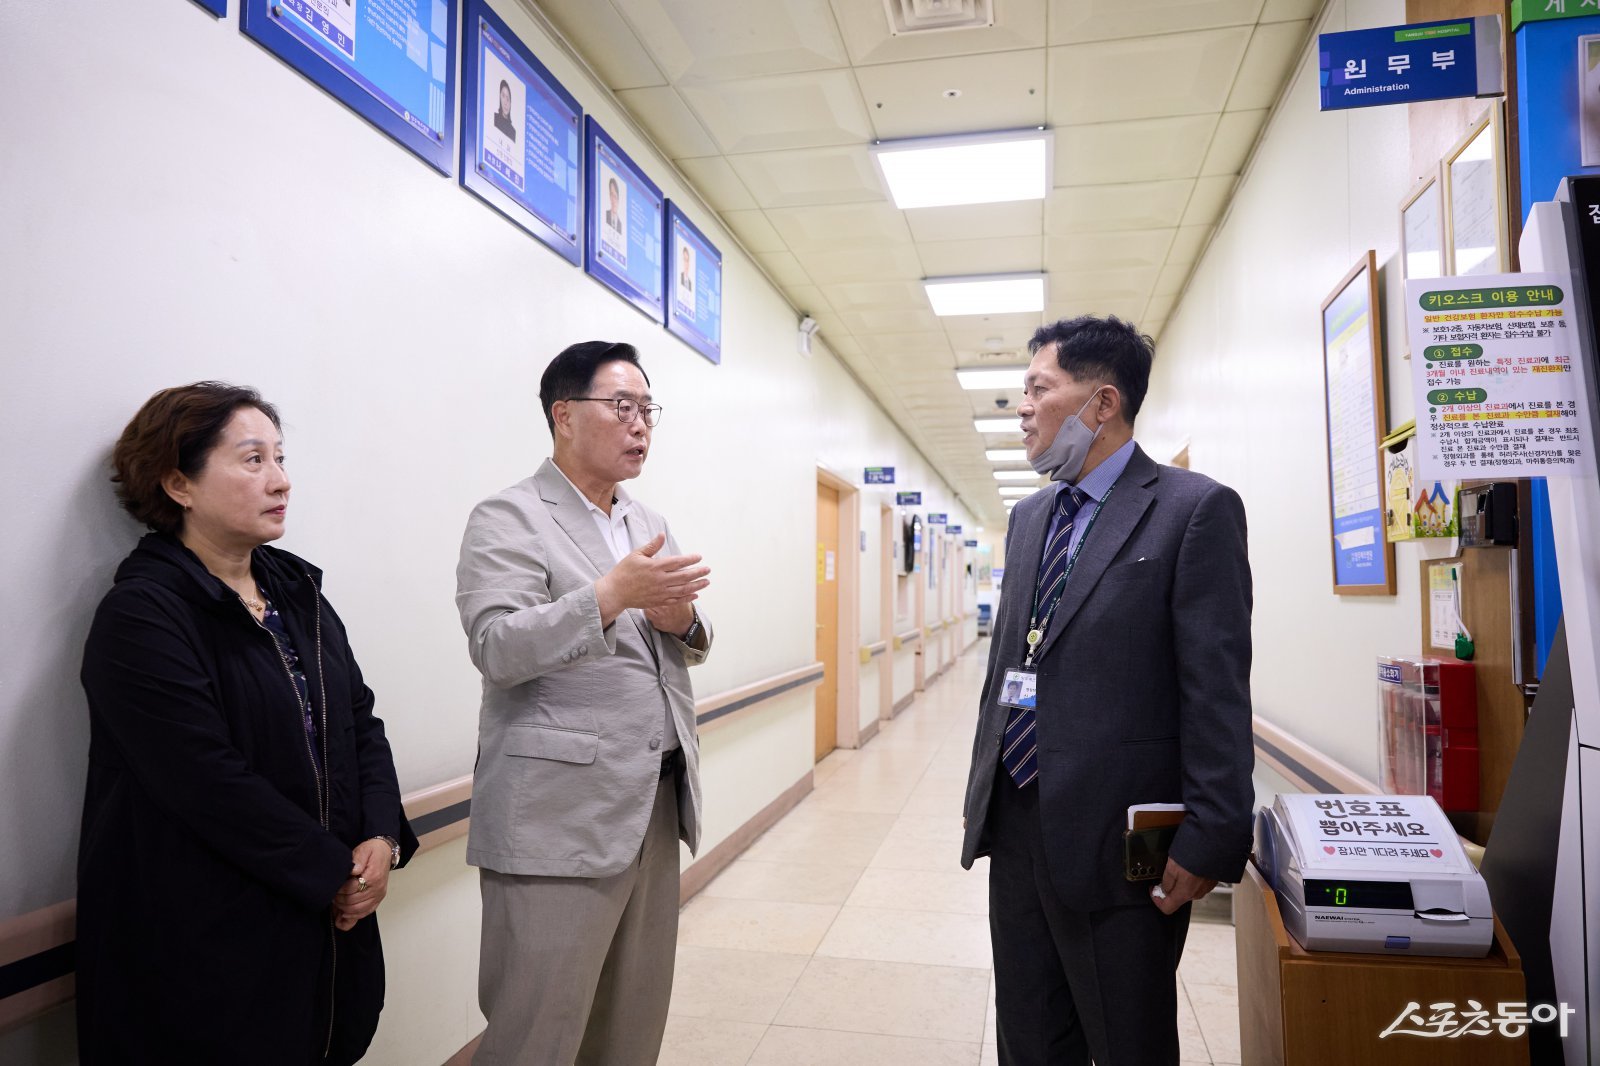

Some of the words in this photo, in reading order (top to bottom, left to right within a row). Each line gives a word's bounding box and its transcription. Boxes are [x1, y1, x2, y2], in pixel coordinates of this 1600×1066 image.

[305, 8, 314, 22] 김
[321, 20, 330, 35] 영
[337, 33, 346, 48] 민
[1344, 59, 1367, 80] 원
[1388, 54, 1411, 75] 무
[1432, 49, 1456, 71] 부
[1344, 82, 1410, 96] Administration
[1428, 292, 1484, 307] 키오스크
[1491, 290, 1519, 303] 이용
[1526, 288, 1554, 301] 안내
[1424, 314, 1440, 323] 일반
[1444, 313, 1476, 322] 건강보험
[1480, 311, 1504, 319] 환자만
[1546, 309, 1563, 317] 가능
[1433, 334, 1447, 342] 기타
[1449, 332, 1478, 340] 보험자격
[1480, 331, 1502, 340] 환자는
[1450, 346, 1473, 357] 접수
[1439, 360, 1462, 368] 진료를
[1467, 359, 1491, 368] 원하는
[1496, 357, 1512, 366] 특정
[1518, 356, 1550, 365] 진료과에
[1554, 355, 1571, 364] 최근
[1426, 369, 1446, 378] 3개월
[1450, 369, 1466, 377] 이내
[1470, 366, 1508, 376] 진료내역이
[1512, 366, 1529, 374] 있는
[1427, 378, 1443, 387] 접수
[1446, 377, 1462, 386] 가능
[1454, 390, 1478, 401] 수납
[1441, 404, 1455, 413] 2개
[1457, 403, 1481, 412] 이상의
[1485, 402, 1525, 411] 진료과에서
[1528, 401, 1552, 409] 진료를
[1555, 401, 1564, 409] 본
[1567, 400, 1576, 409] 경
[1430, 414, 1438, 422] 우
[1443, 413, 1466, 422] 진료를
[1472, 412, 1481, 421] 본
[1486, 411, 1510, 420] 진료과
[1515, 410, 1539, 419] 수만큼
[1430, 421, 1469, 431] 정상적으로
[1473, 420, 1505, 429] 수납완료
[1439, 430, 1451, 438] 2개
[1453, 429, 1474, 438] 이상의
[1477, 428, 1511, 437] 진료과에서
[1513, 427, 1534, 436] 진료를
[1537, 427, 1544, 435] 본
[1548, 427, 1561, 435] 경우
[1439, 437, 1460, 445] 수납시
[1464, 436, 1498, 445] 합계금액이
[1502, 435, 1529, 444] 표시되나
[1559, 434, 1580, 442] 반드시
[1440, 445, 1453, 453] 진료
[1457, 444, 1464, 452] 본
[1466, 444, 1487, 452] 진료과
[1489, 443, 1509, 451] 수만큼
[1442, 452, 1476, 460] 정형외과를
[1480, 451, 1495, 459] 통해
[1443, 459, 1457, 468] 경우
[1469, 458, 1477, 467] 번
[1315, 800, 1411, 819] 번호표
[1319, 820, 1430, 837] 뽑아주세요
[1338, 846, 1367, 857] 잠시만
[1369, 847, 1398, 857] 기다려
[1401, 848, 1430, 858] 주세요
[1335, 888, 1347, 905] 0
